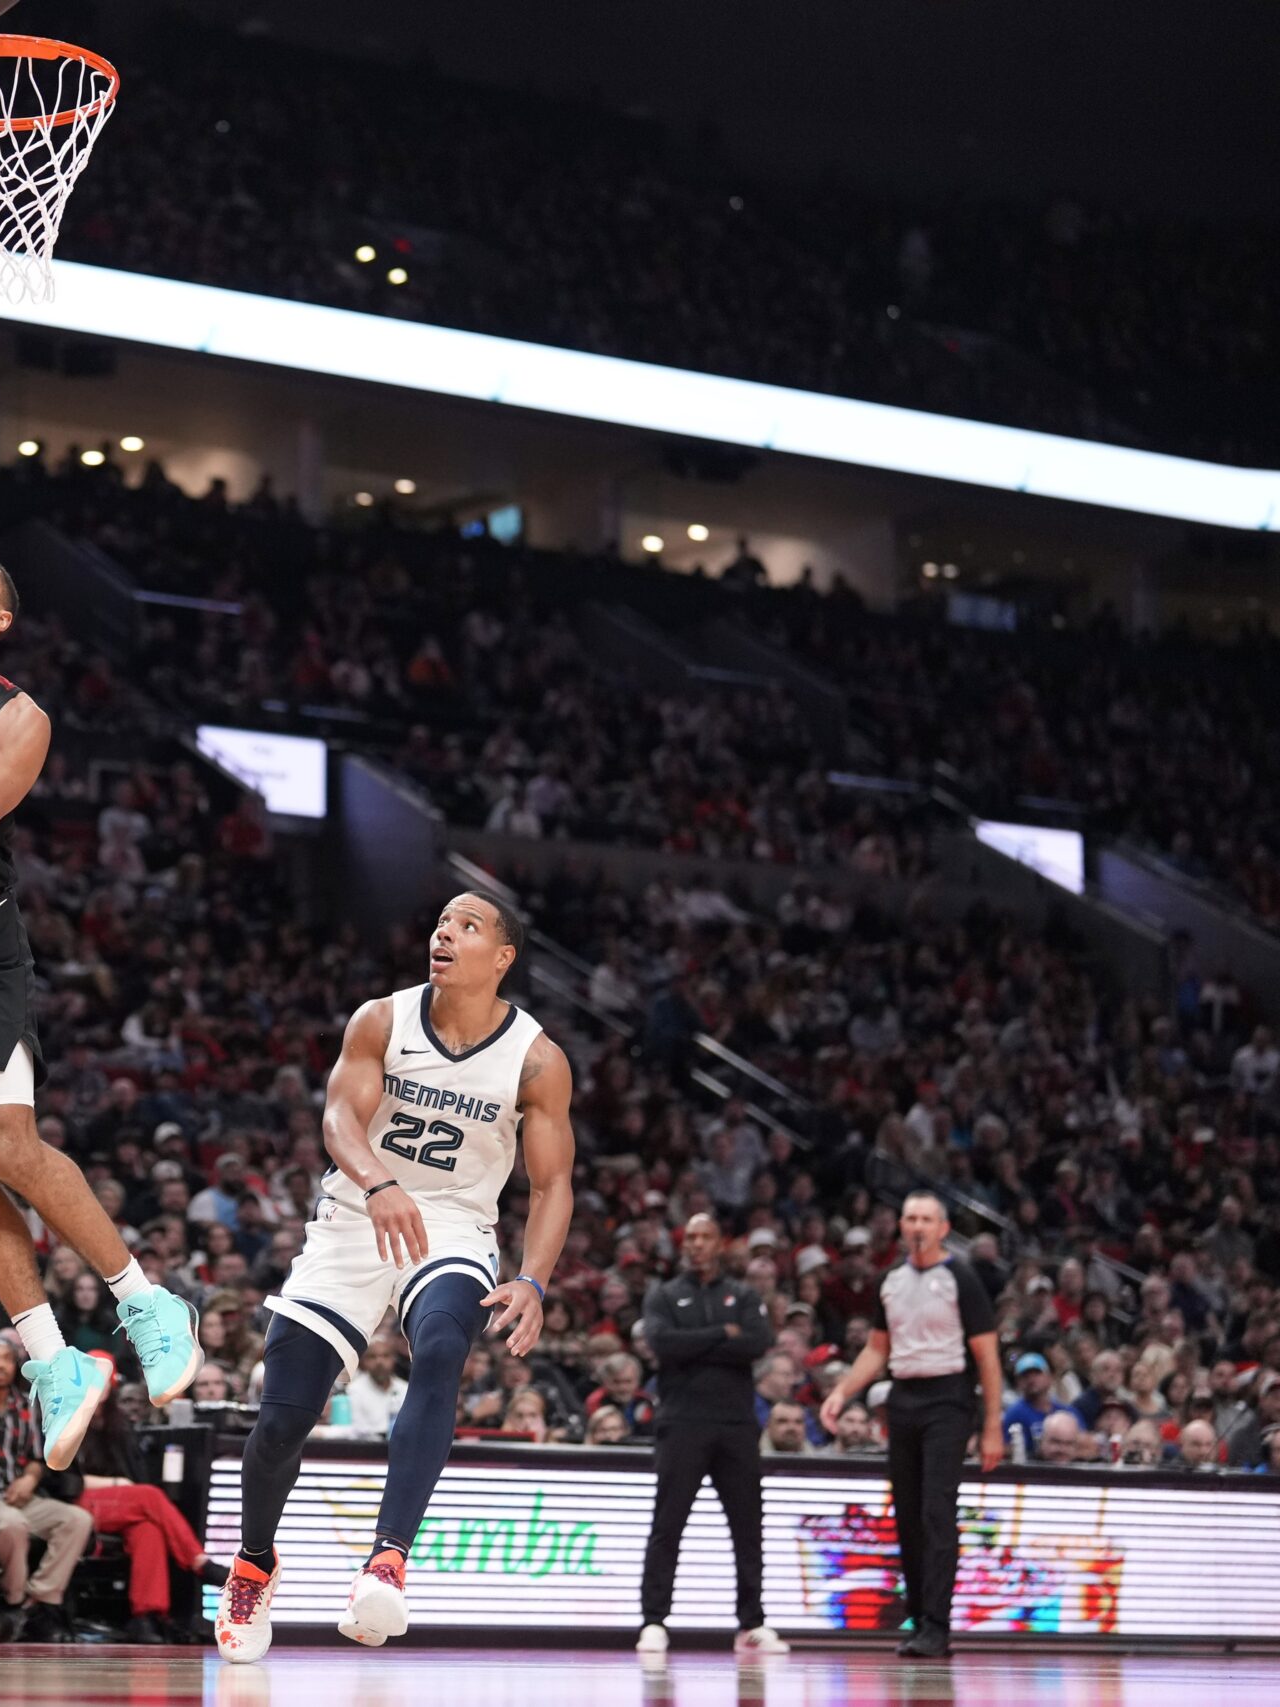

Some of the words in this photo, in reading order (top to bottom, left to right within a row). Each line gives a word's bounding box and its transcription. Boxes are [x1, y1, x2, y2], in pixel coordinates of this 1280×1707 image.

[383, 1072, 501, 1123] MEMPHIS
[380, 1111, 465, 1172] 22
[408, 1489, 604, 1579] amba
